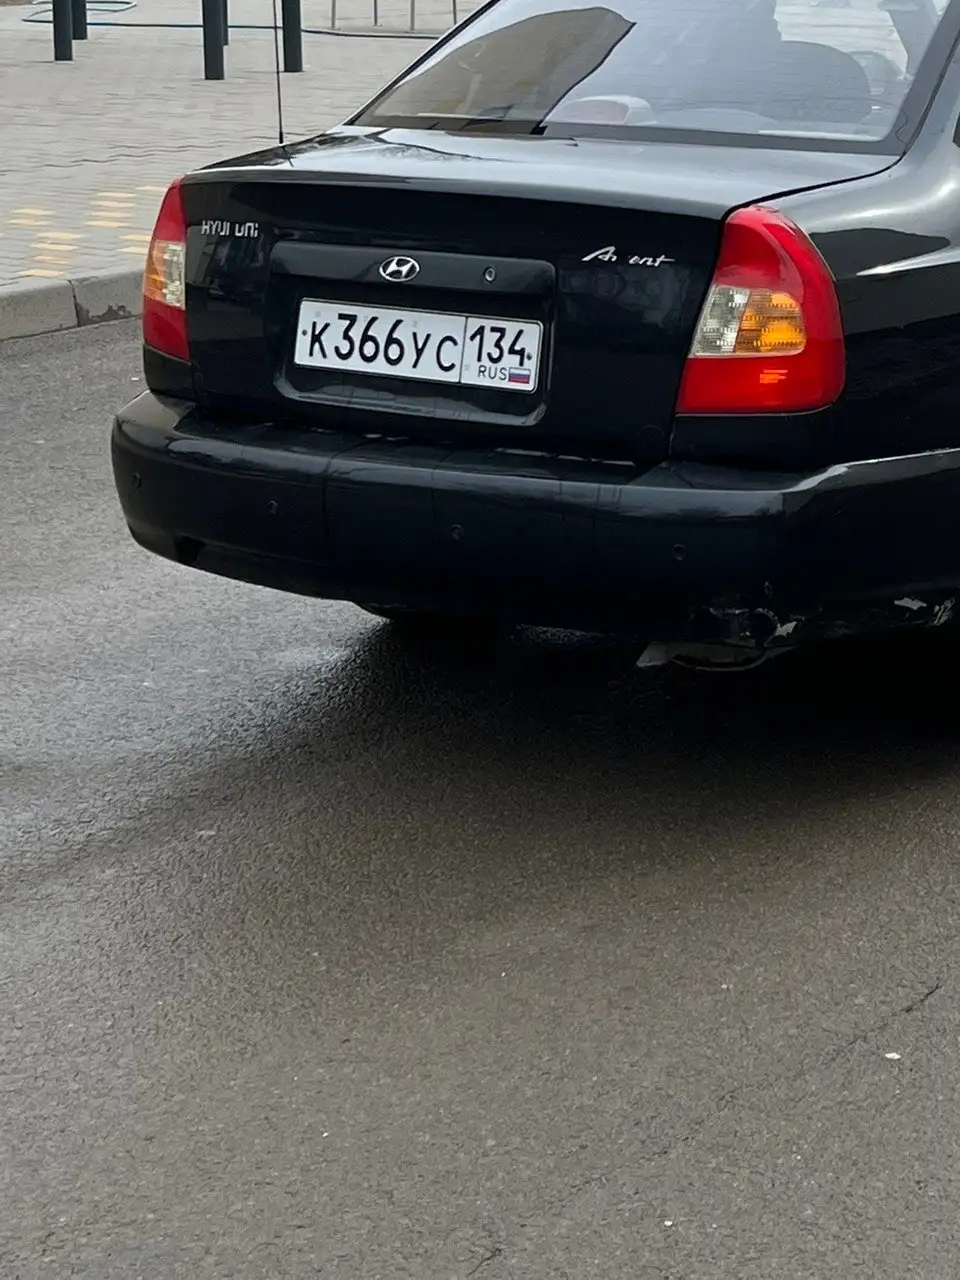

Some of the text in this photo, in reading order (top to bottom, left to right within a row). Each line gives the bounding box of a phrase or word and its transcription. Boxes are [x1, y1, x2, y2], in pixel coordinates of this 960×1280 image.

[308, 313, 526, 372] К366УС 134
[477, 363, 508, 382] RUS
